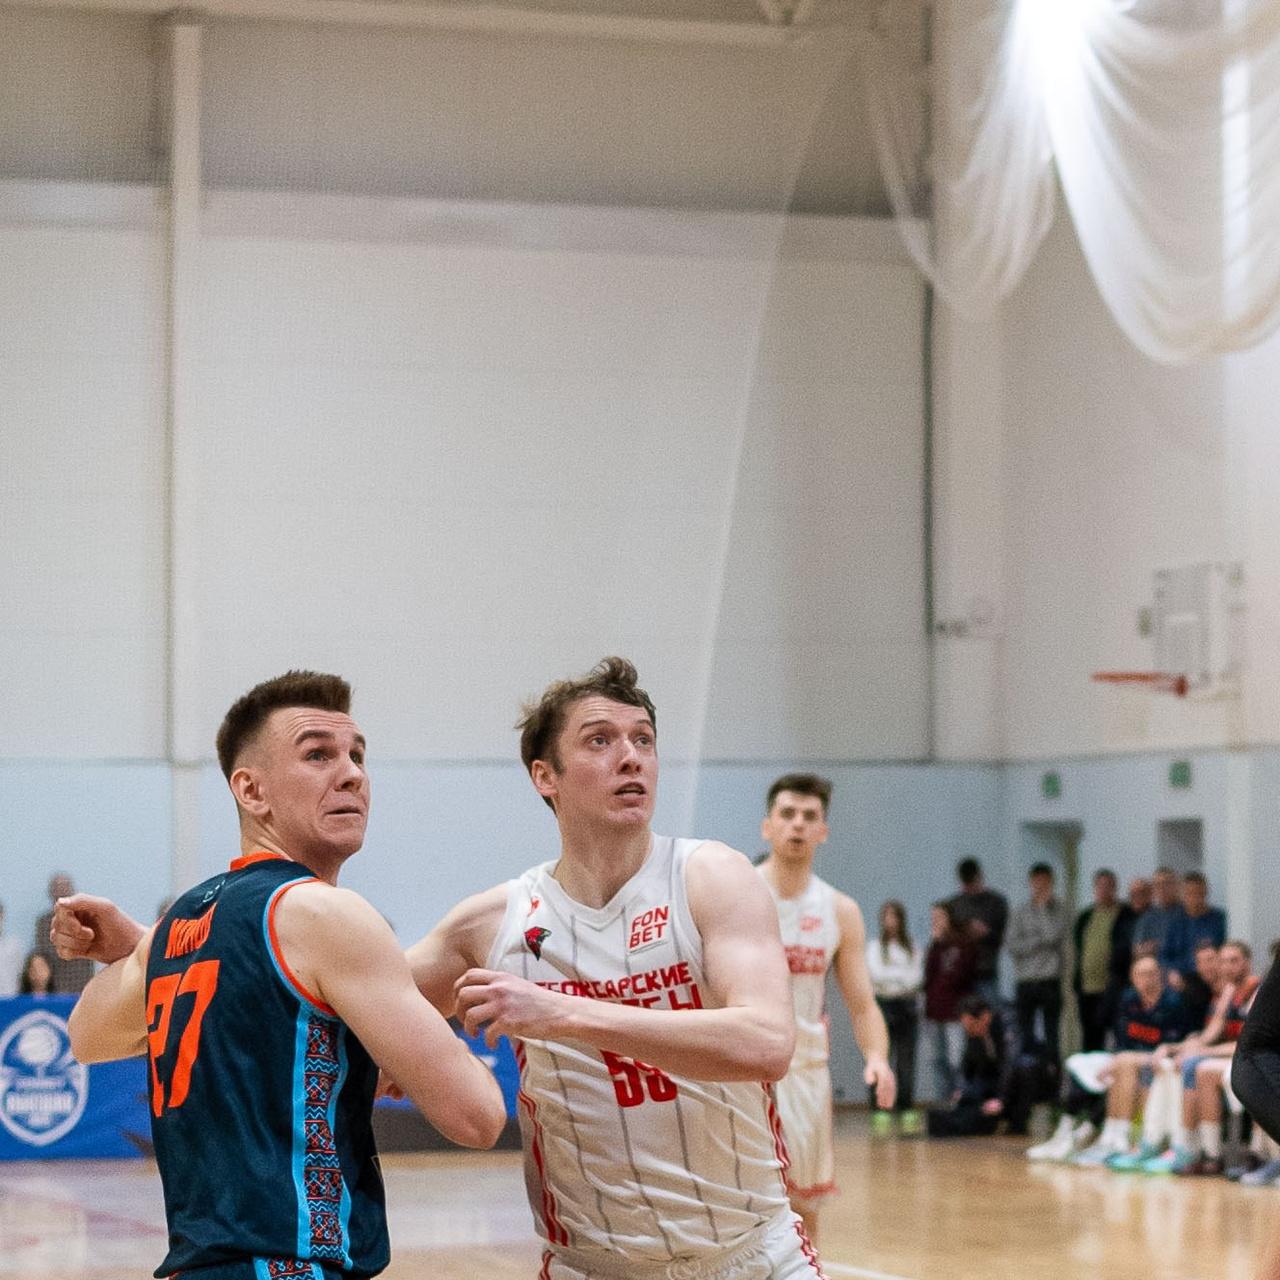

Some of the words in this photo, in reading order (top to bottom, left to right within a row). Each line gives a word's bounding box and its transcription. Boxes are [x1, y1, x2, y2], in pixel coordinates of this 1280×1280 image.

[632, 905, 669, 933] FON
[629, 922, 668, 949] BET
[146, 959, 221, 1118] 27
